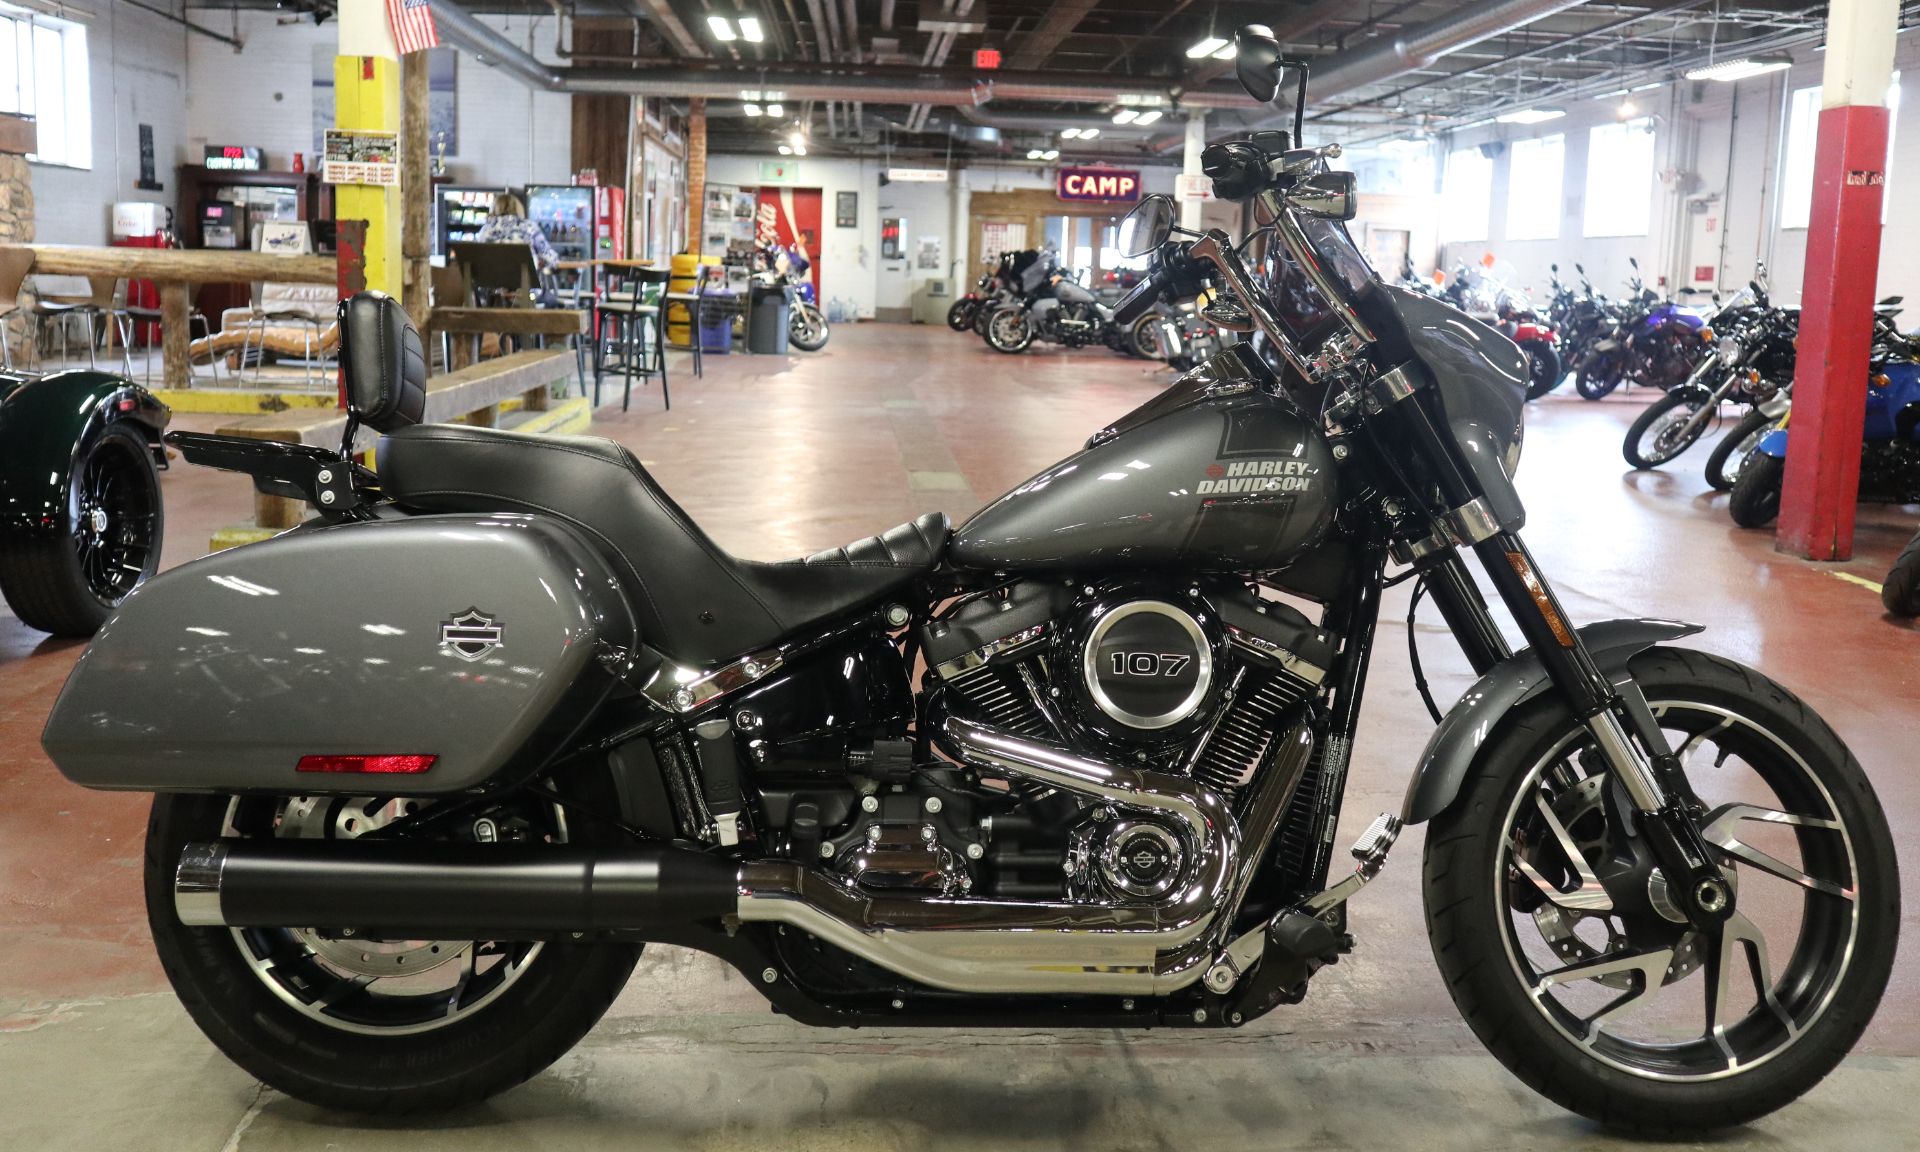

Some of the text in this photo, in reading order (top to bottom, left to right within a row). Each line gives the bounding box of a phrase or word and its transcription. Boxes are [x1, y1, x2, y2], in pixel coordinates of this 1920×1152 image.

[1065, 175, 1135, 197] CAMP
[1195, 476, 1310, 495] DAVIDSON
[1111, 651, 1191, 677] 107
